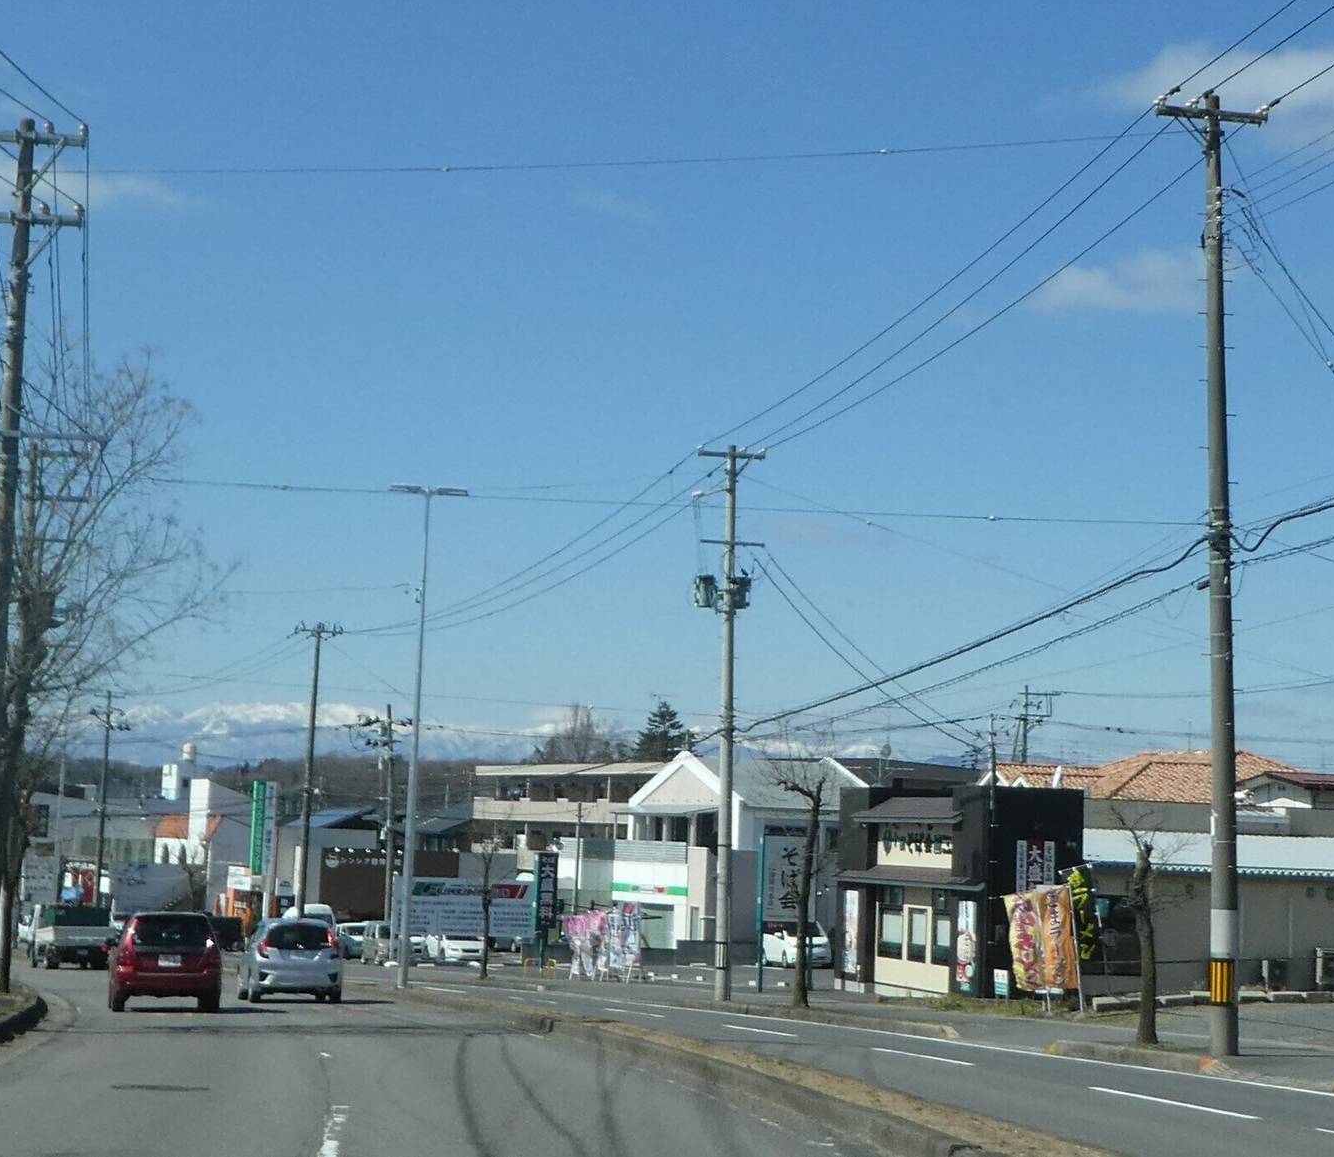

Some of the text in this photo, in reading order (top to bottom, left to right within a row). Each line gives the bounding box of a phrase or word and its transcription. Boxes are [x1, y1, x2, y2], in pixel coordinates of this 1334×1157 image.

[340, 857, 401, 866] シンシア動物院
